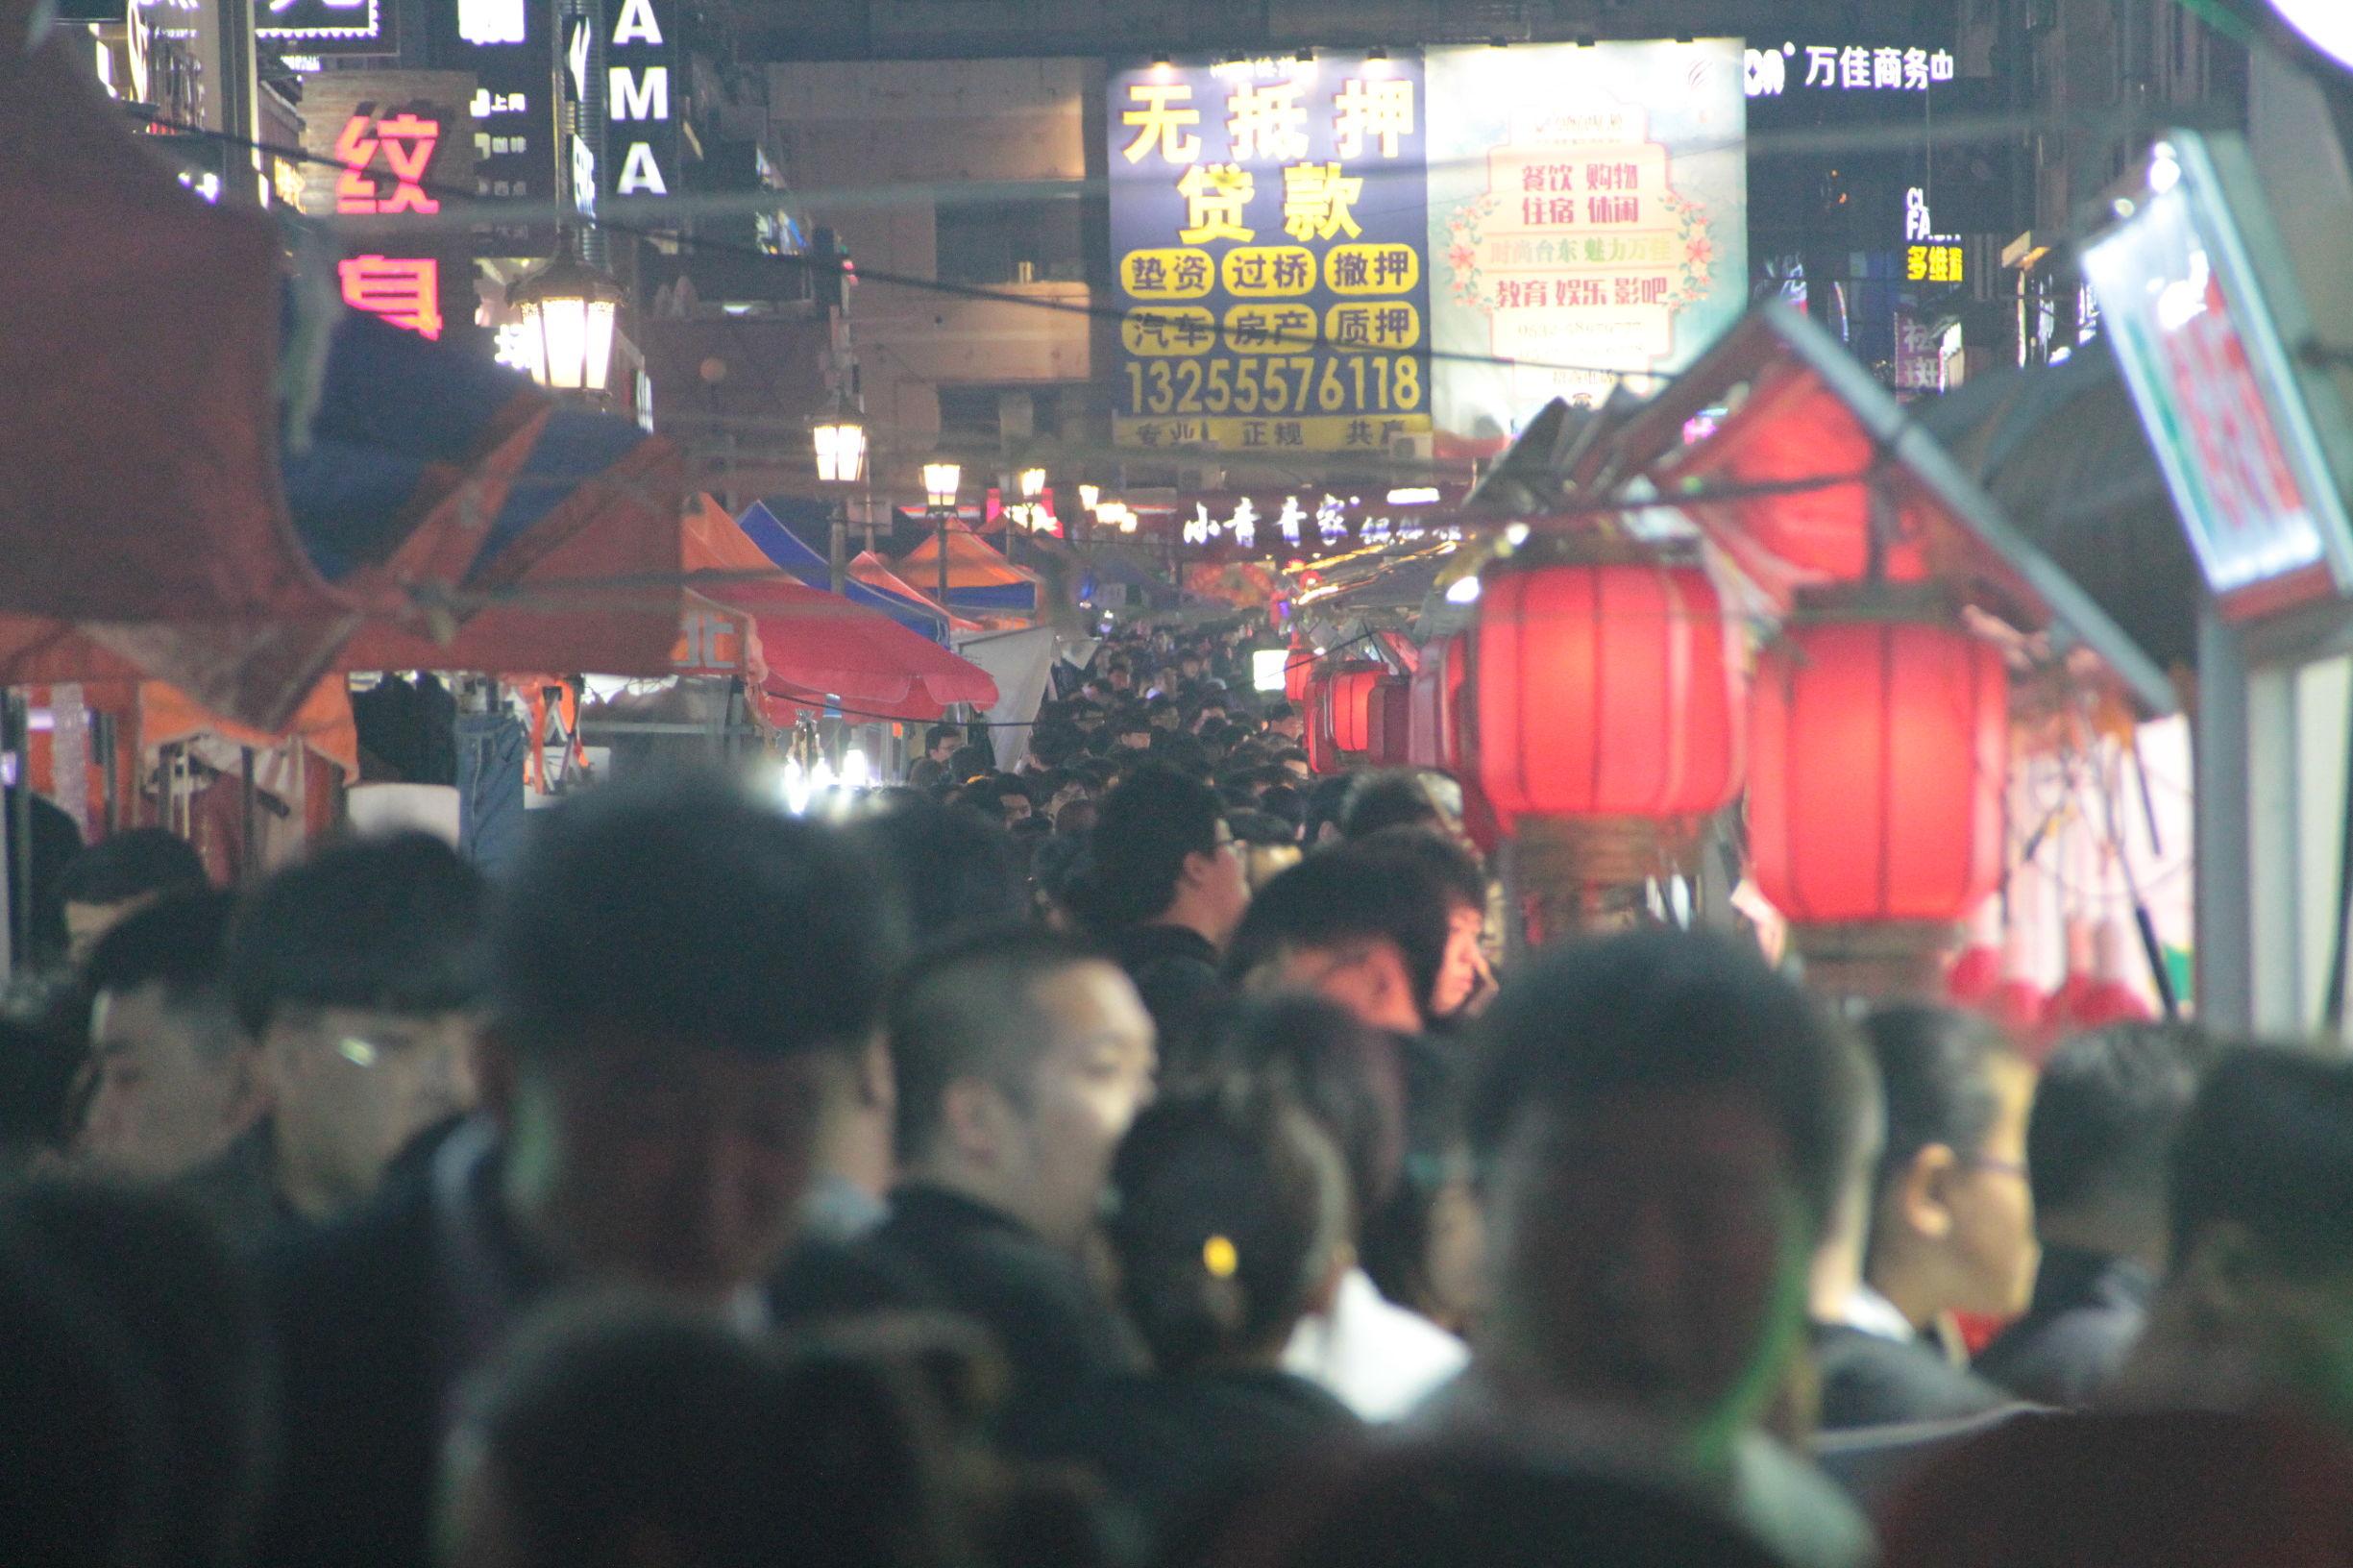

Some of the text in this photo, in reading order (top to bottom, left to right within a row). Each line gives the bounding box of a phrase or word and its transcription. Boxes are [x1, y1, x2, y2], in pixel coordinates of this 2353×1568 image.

[1120, 79, 1413, 163] 无抵押
[1522, 162, 1638, 191] 餐饮 购物
[1177, 161, 1363, 244] 贷款
[1523, 196, 1638, 225] 住宿 休闲
[1132, 256, 1208, 291] 垫资
[1233, 254, 1308, 288] 过桥
[1498, 280, 1548, 307] 教育
[1556, 279, 1607, 306] 娱乐
[1134, 307, 1409, 348] 汽车 房产 质押
[1125, 355, 1420, 414] 13255576118
